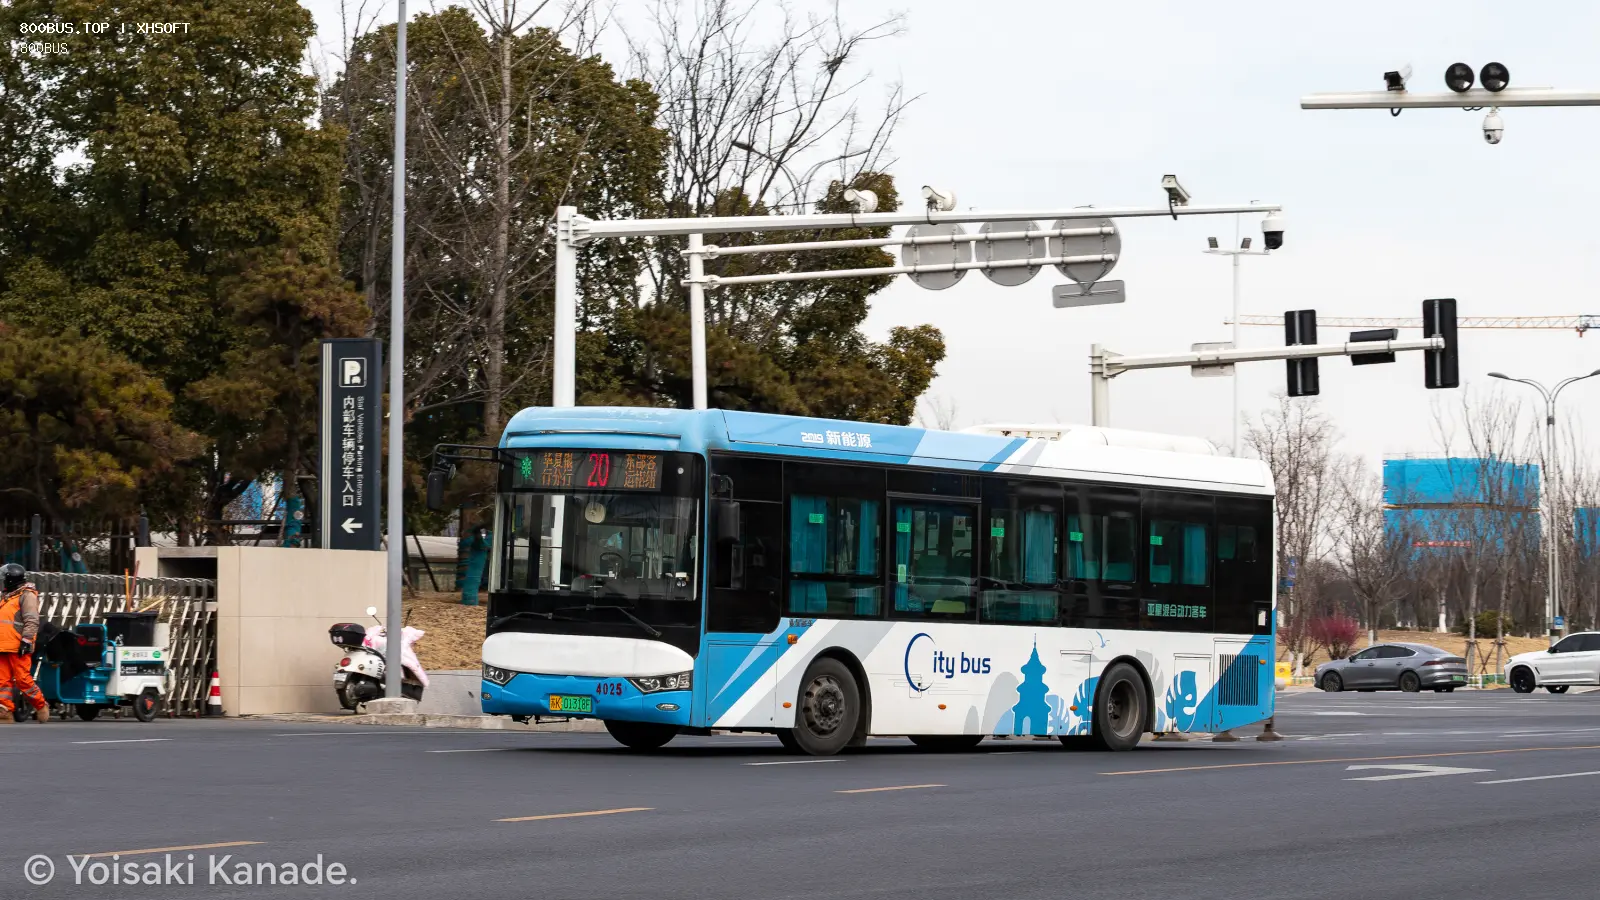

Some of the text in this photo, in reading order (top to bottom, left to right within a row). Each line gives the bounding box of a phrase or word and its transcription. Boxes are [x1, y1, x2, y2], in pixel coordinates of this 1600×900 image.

[342, 395, 356, 507] 内部车辆停车入口
[826, 430, 873, 449] 新能源
[355, 445, 365, 473] Parking
[587, 453, 610, 487] 20
[356, 474, 364, 507] Entrance
[1147, 603, 1207, 618] 亚星混合动力客车
[904, 632, 991, 692] City bus
[596, 682, 623, 696] 4025
